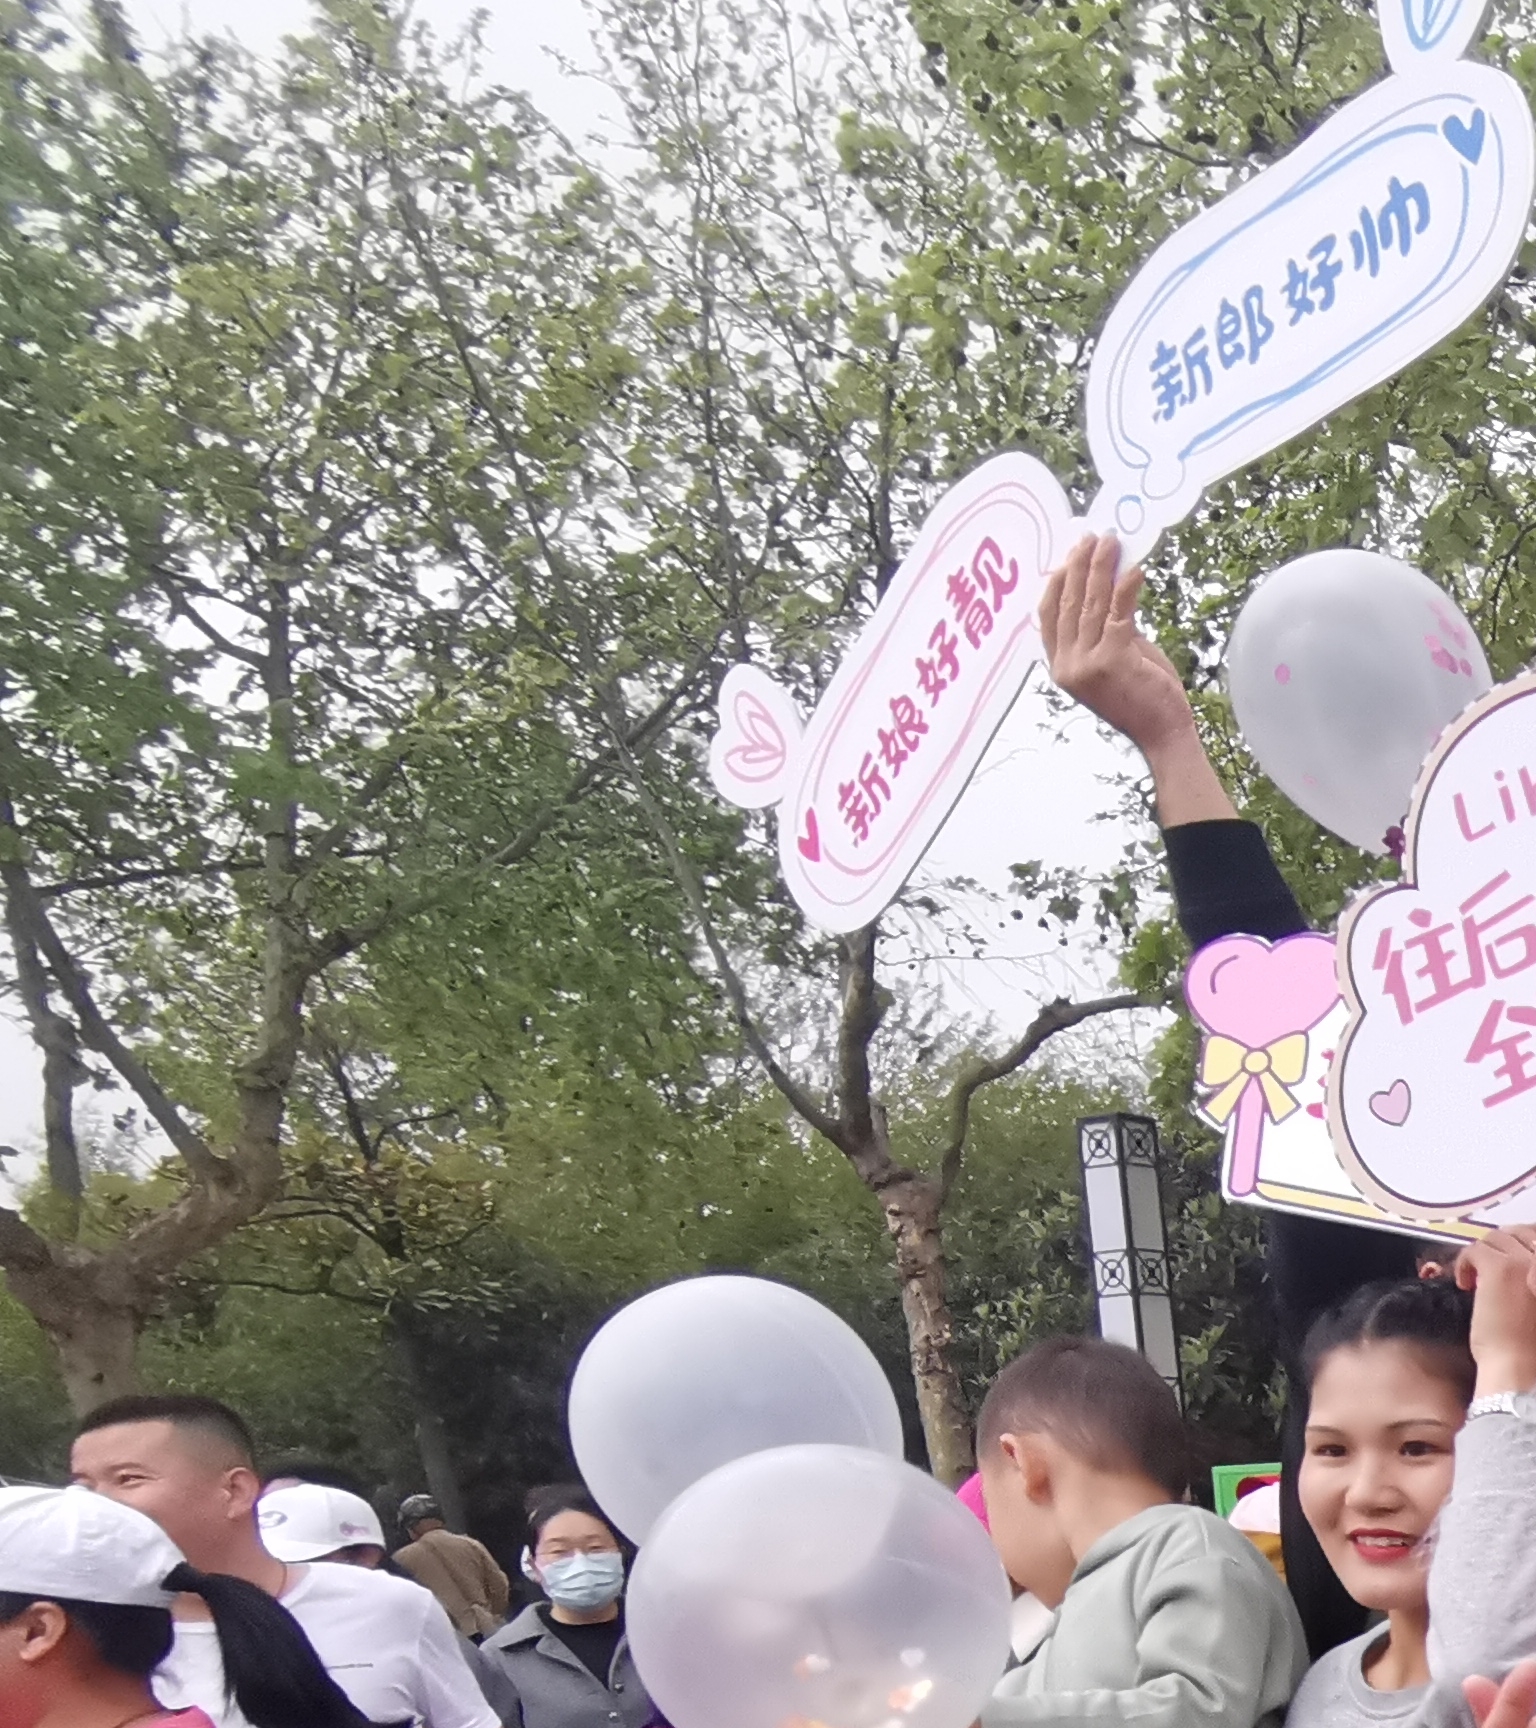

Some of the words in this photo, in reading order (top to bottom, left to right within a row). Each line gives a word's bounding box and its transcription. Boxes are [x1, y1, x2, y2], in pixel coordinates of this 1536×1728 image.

[1147, 176, 1431, 422] 新郎好帅
[836, 536, 1020, 848] 新娘好靓
